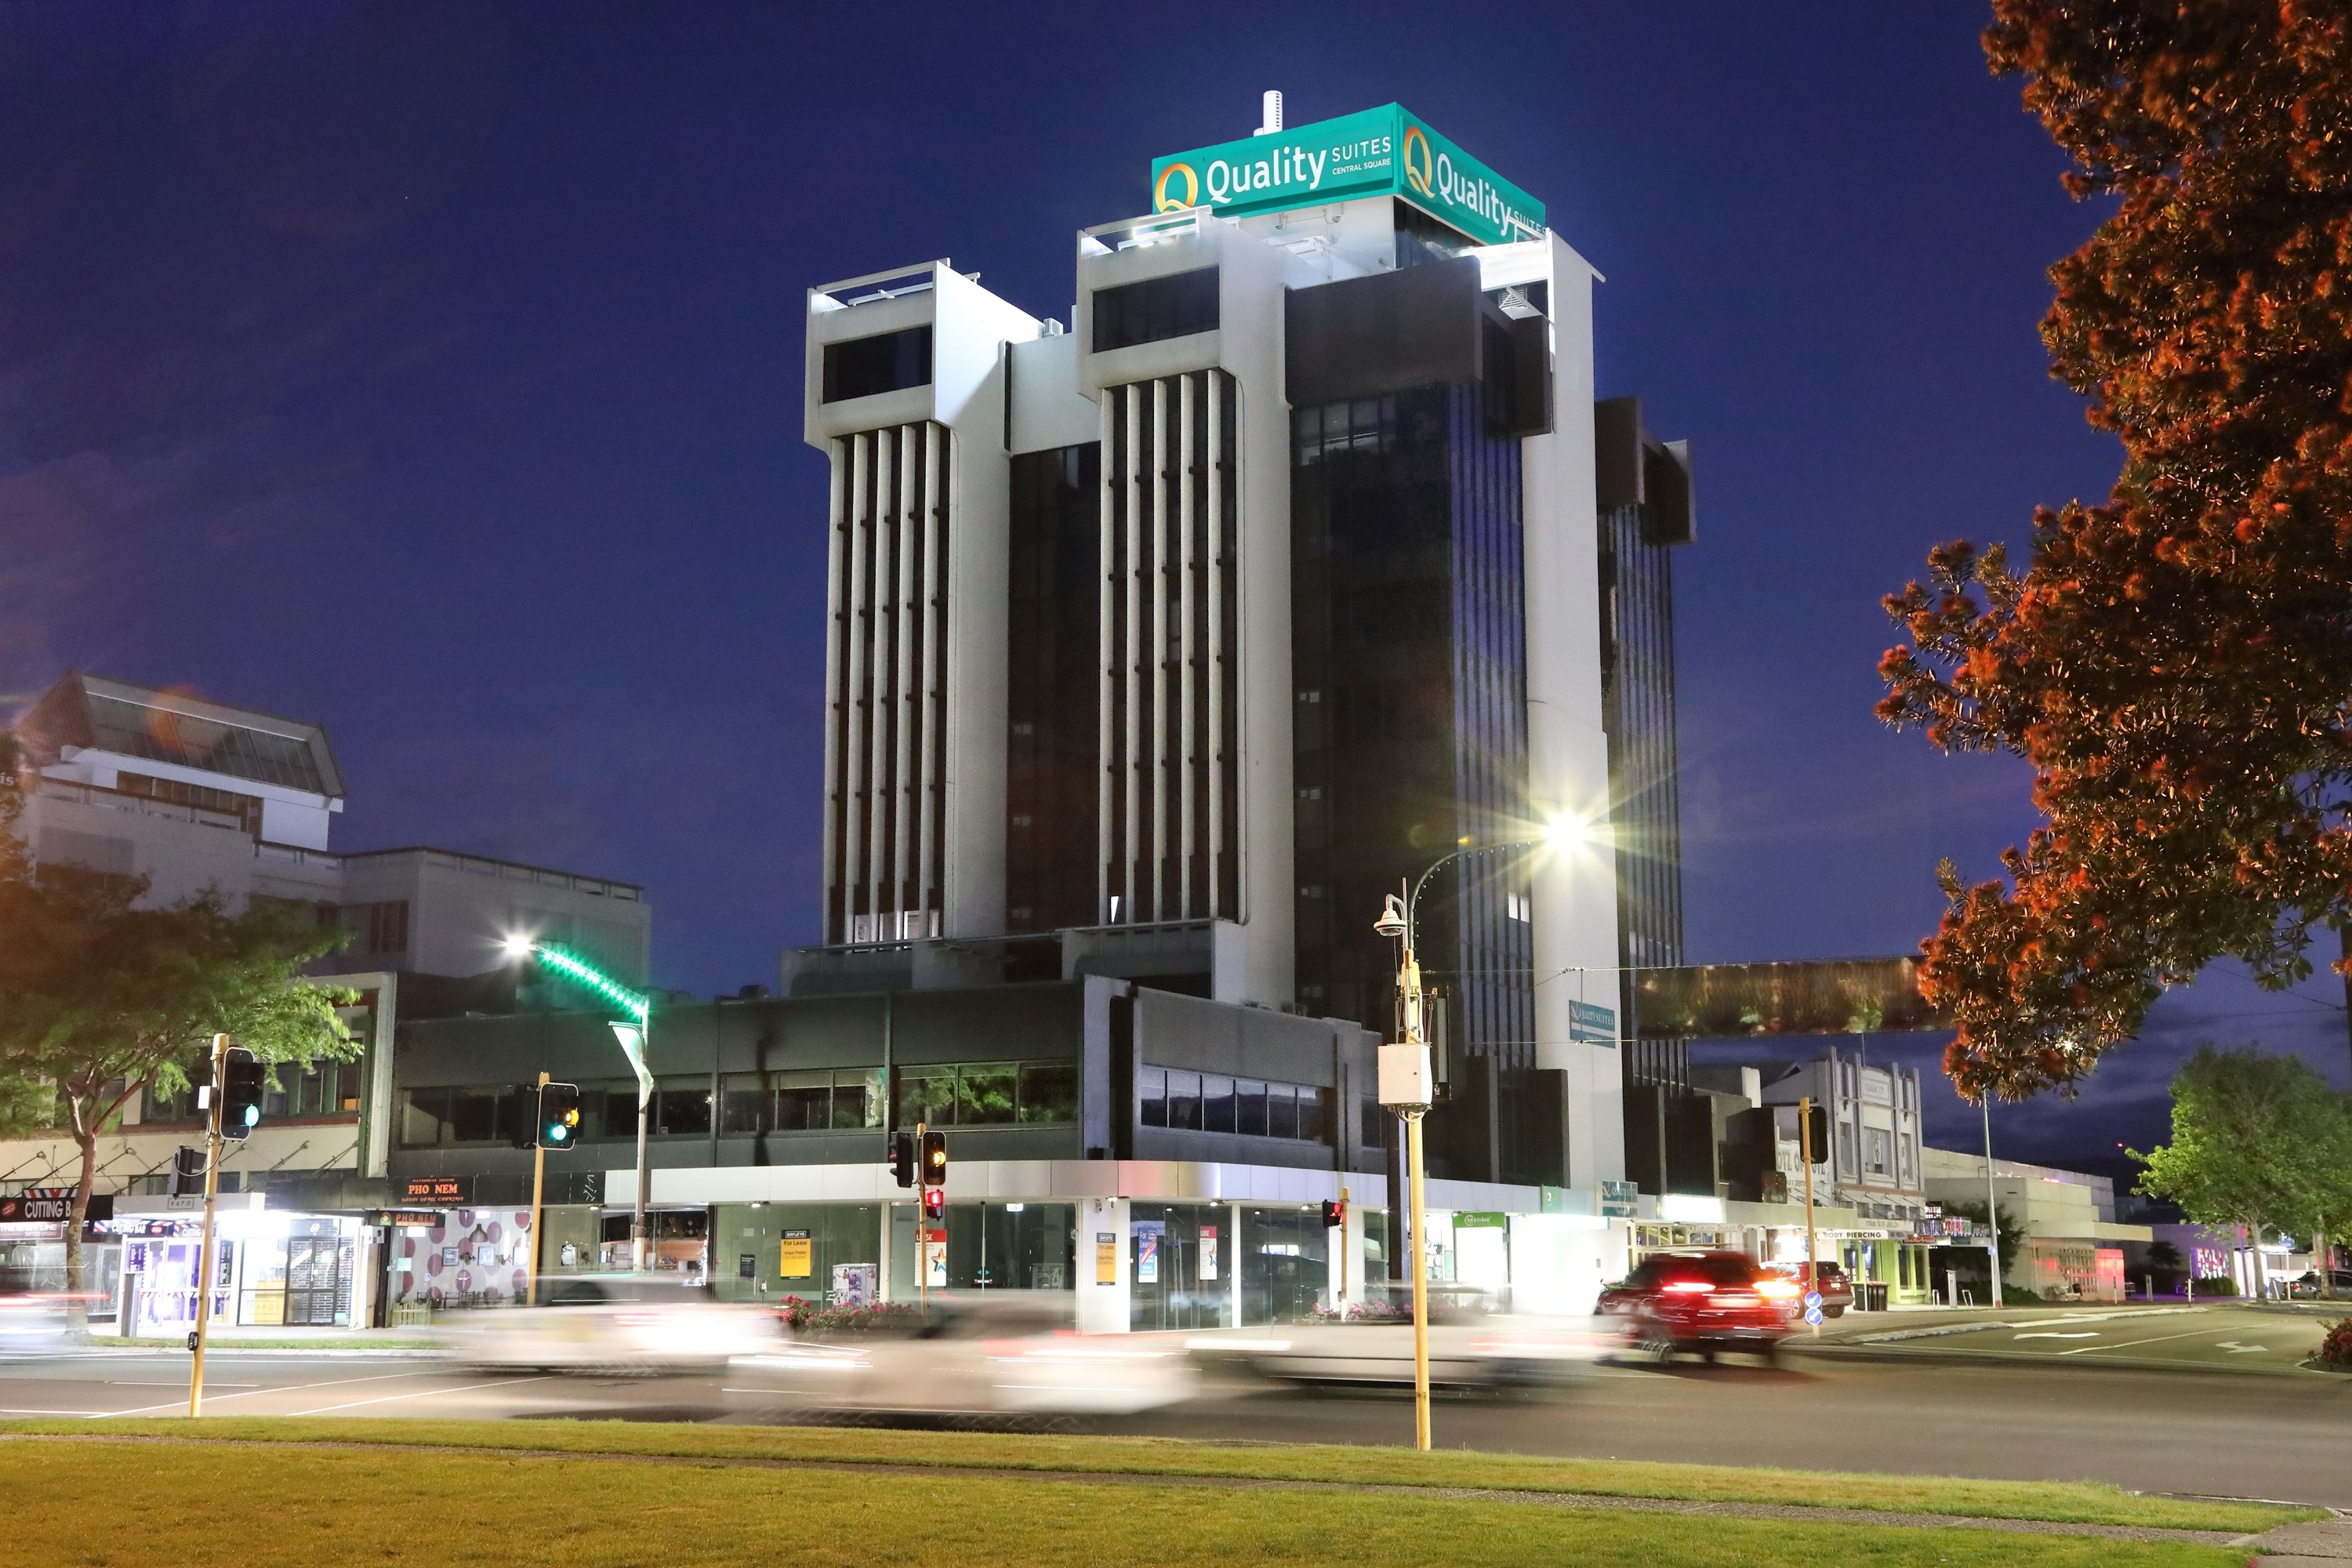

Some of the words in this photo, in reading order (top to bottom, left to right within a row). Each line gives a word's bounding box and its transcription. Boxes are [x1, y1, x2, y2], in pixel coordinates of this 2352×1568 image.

[1332, 136, 1391, 162] SUITES
[1332, 164, 1362, 175] CENTRAL
[1363, 158, 1391, 169] SQUARE
[1206, 146, 1327, 204] Quality
[1438, 154, 1512, 236] Quality
[1595, 1014, 1614, 1025] SUITES
[408, 1185, 430, 1194] PHO
[435, 1184, 458, 1194] NEM
[24, 1201, 63, 1218] CUTTING
[418, 1214, 436, 1222] NEM
[134, 1224, 147, 1234] BAR
[310, 1223, 320, 1233] 69
